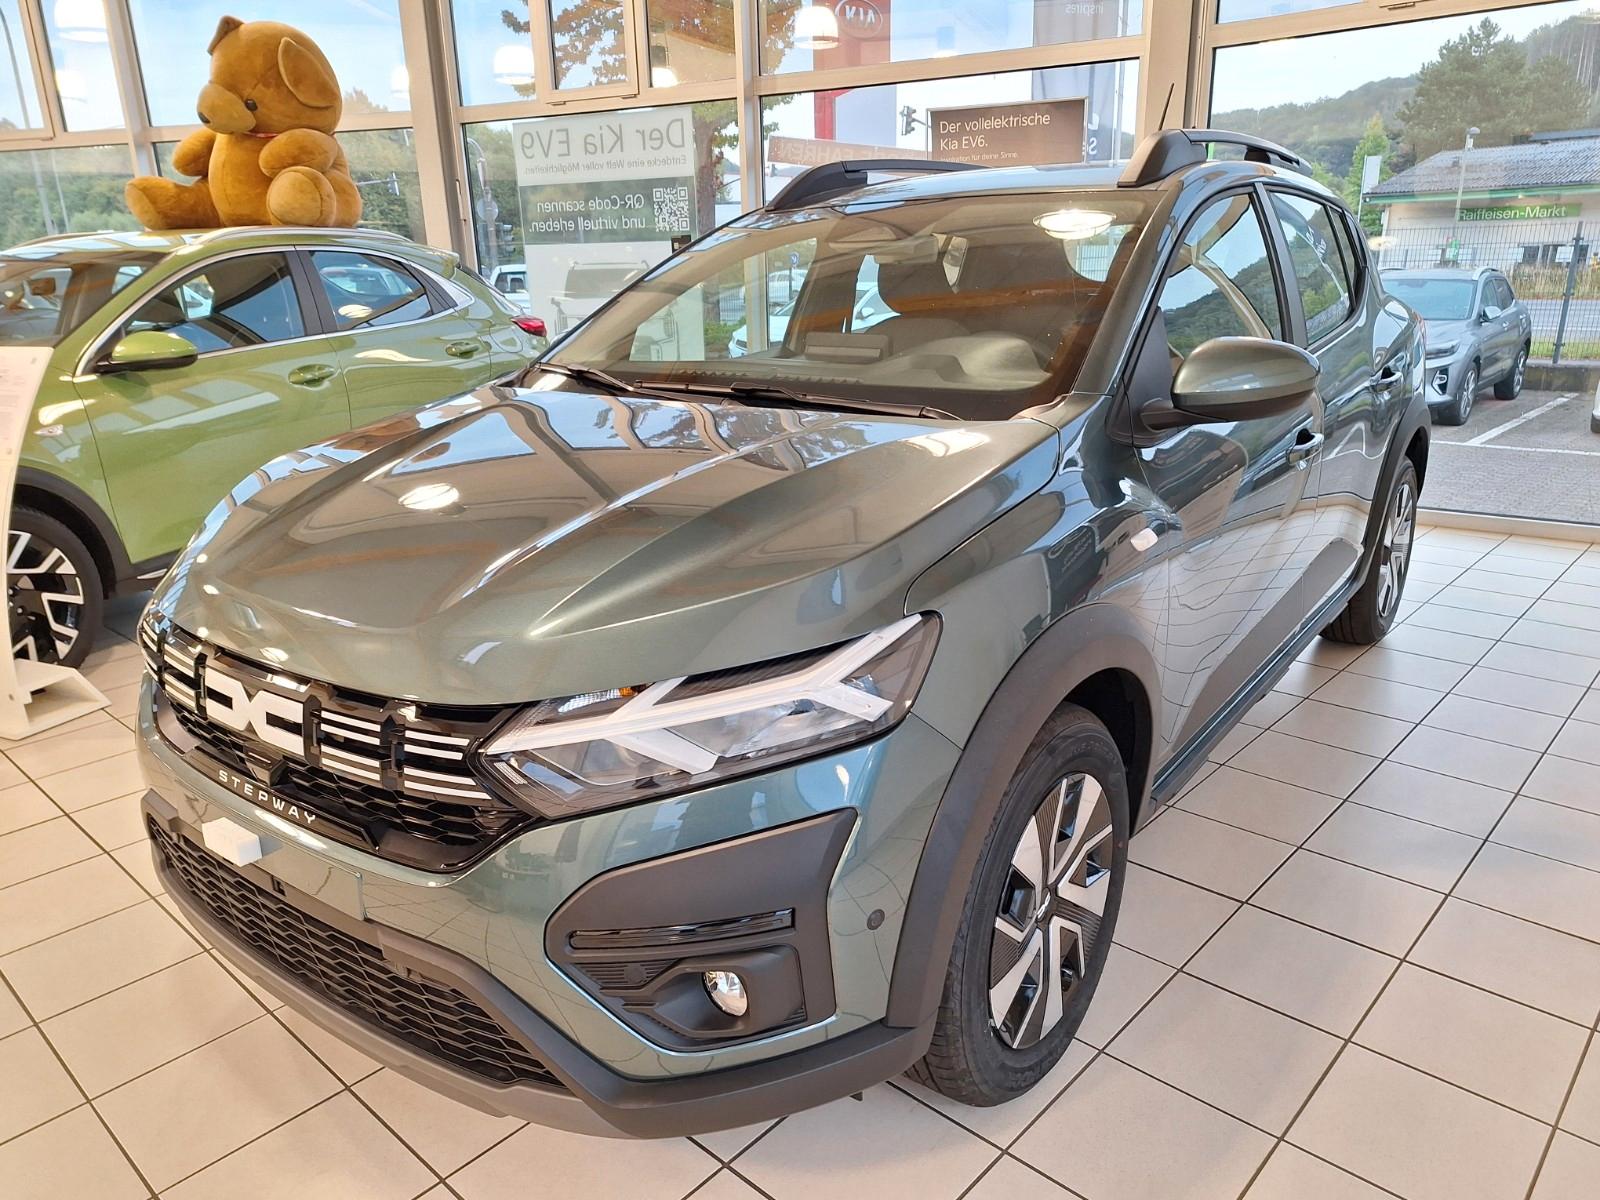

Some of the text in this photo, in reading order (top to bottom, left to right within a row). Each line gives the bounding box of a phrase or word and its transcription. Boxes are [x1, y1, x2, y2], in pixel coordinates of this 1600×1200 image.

[939, 112, 1051, 134] Der vollelektrische
[940, 135, 989, 150] Kia EV6.
[1458, 204, 1567, 221] Raiffeisen-Markt
[218, 769, 316, 825] STEPWAY
